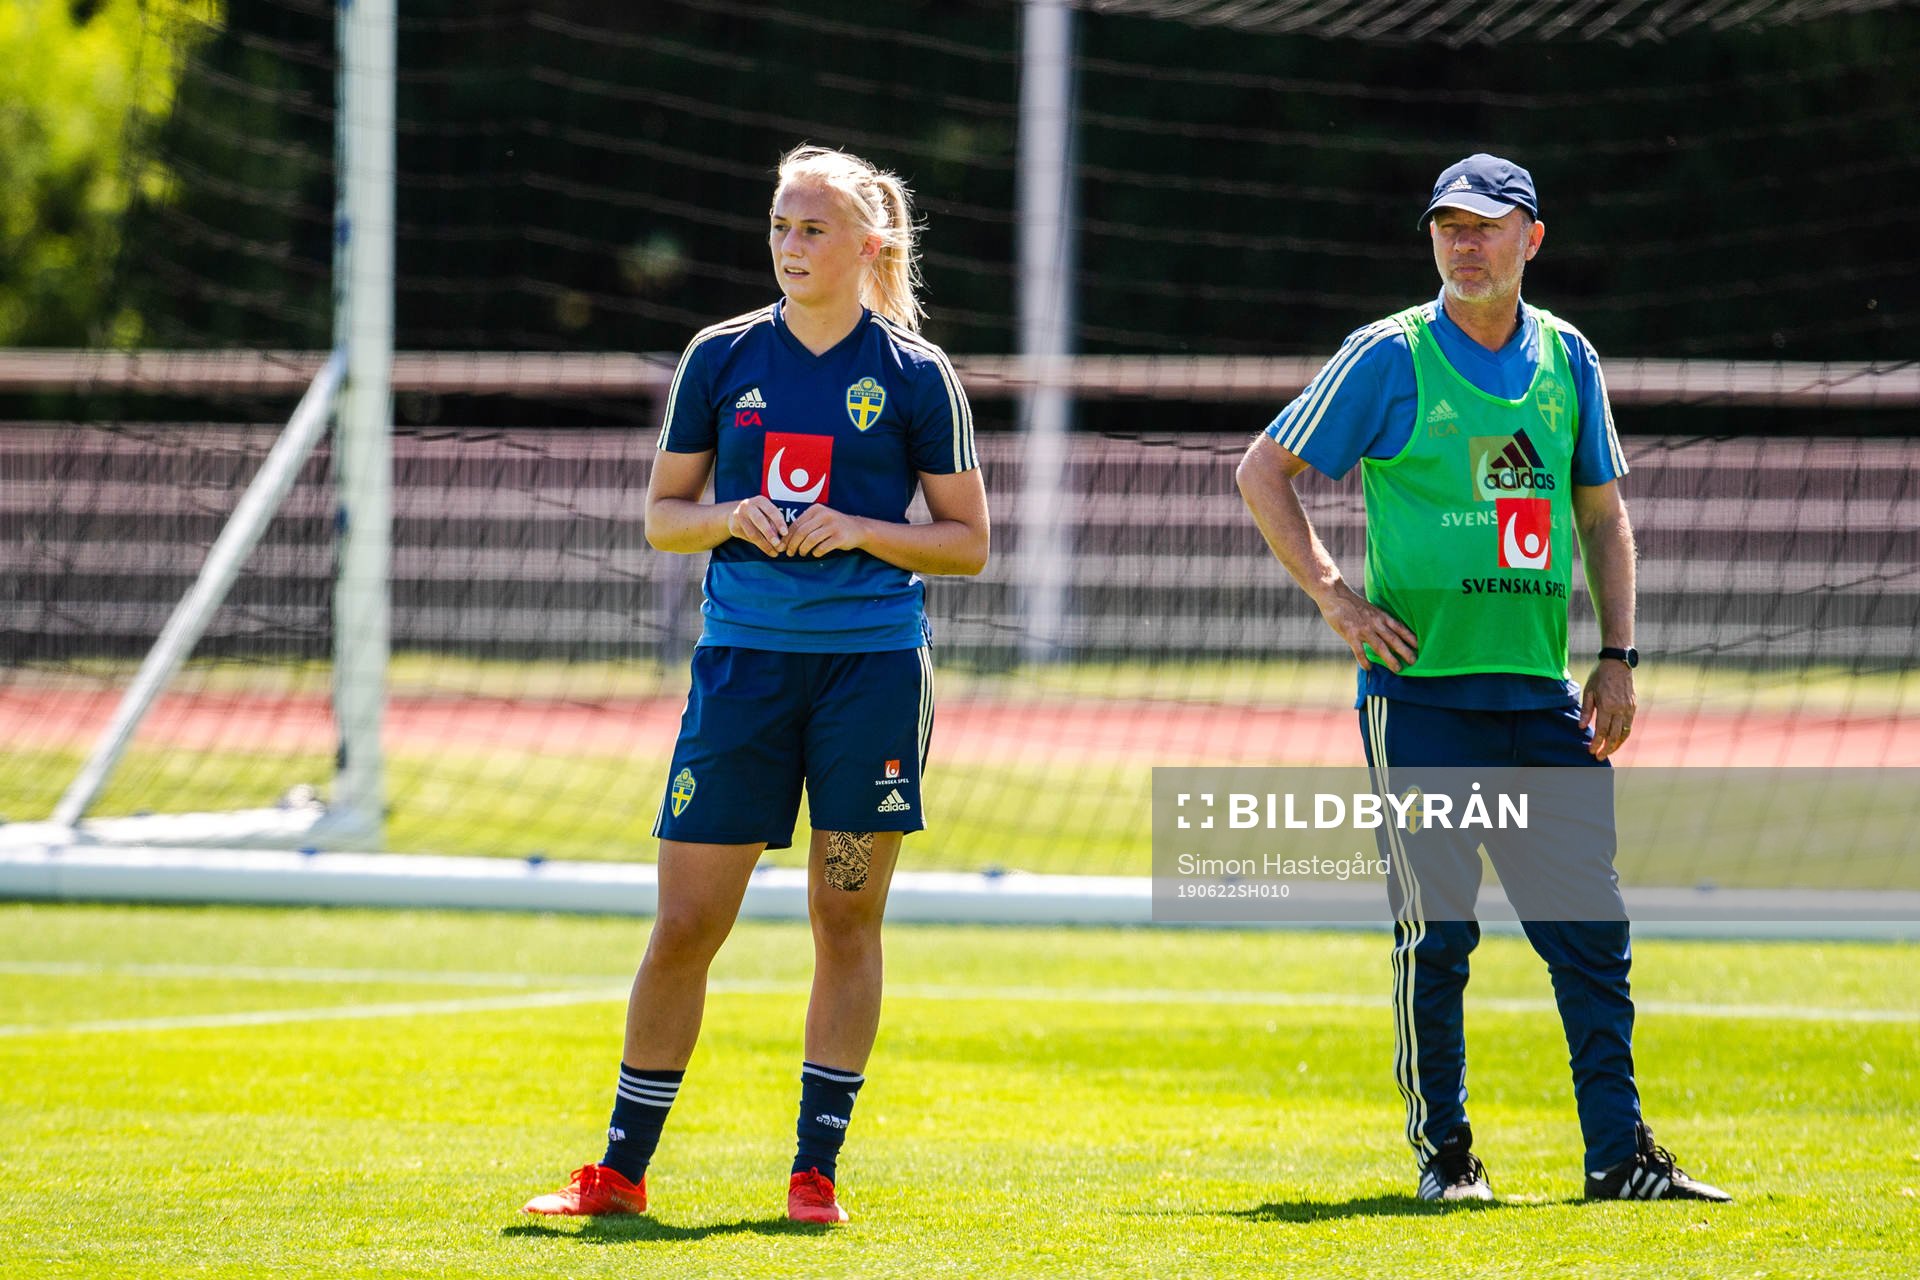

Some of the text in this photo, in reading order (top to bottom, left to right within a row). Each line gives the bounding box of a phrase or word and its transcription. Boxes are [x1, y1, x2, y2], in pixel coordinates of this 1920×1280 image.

[735, 399, 767, 409] adidas
[735, 411, 762, 428] ICA
[1426, 411, 1459, 423] adidas
[1428, 423, 1457, 438] ICA
[1484, 467, 1555, 490] adidas
[1441, 510, 1499, 528] SVENS
[1461, 578, 1567, 600] SVENSKA SPEL
[877, 802, 911, 813] adidas
